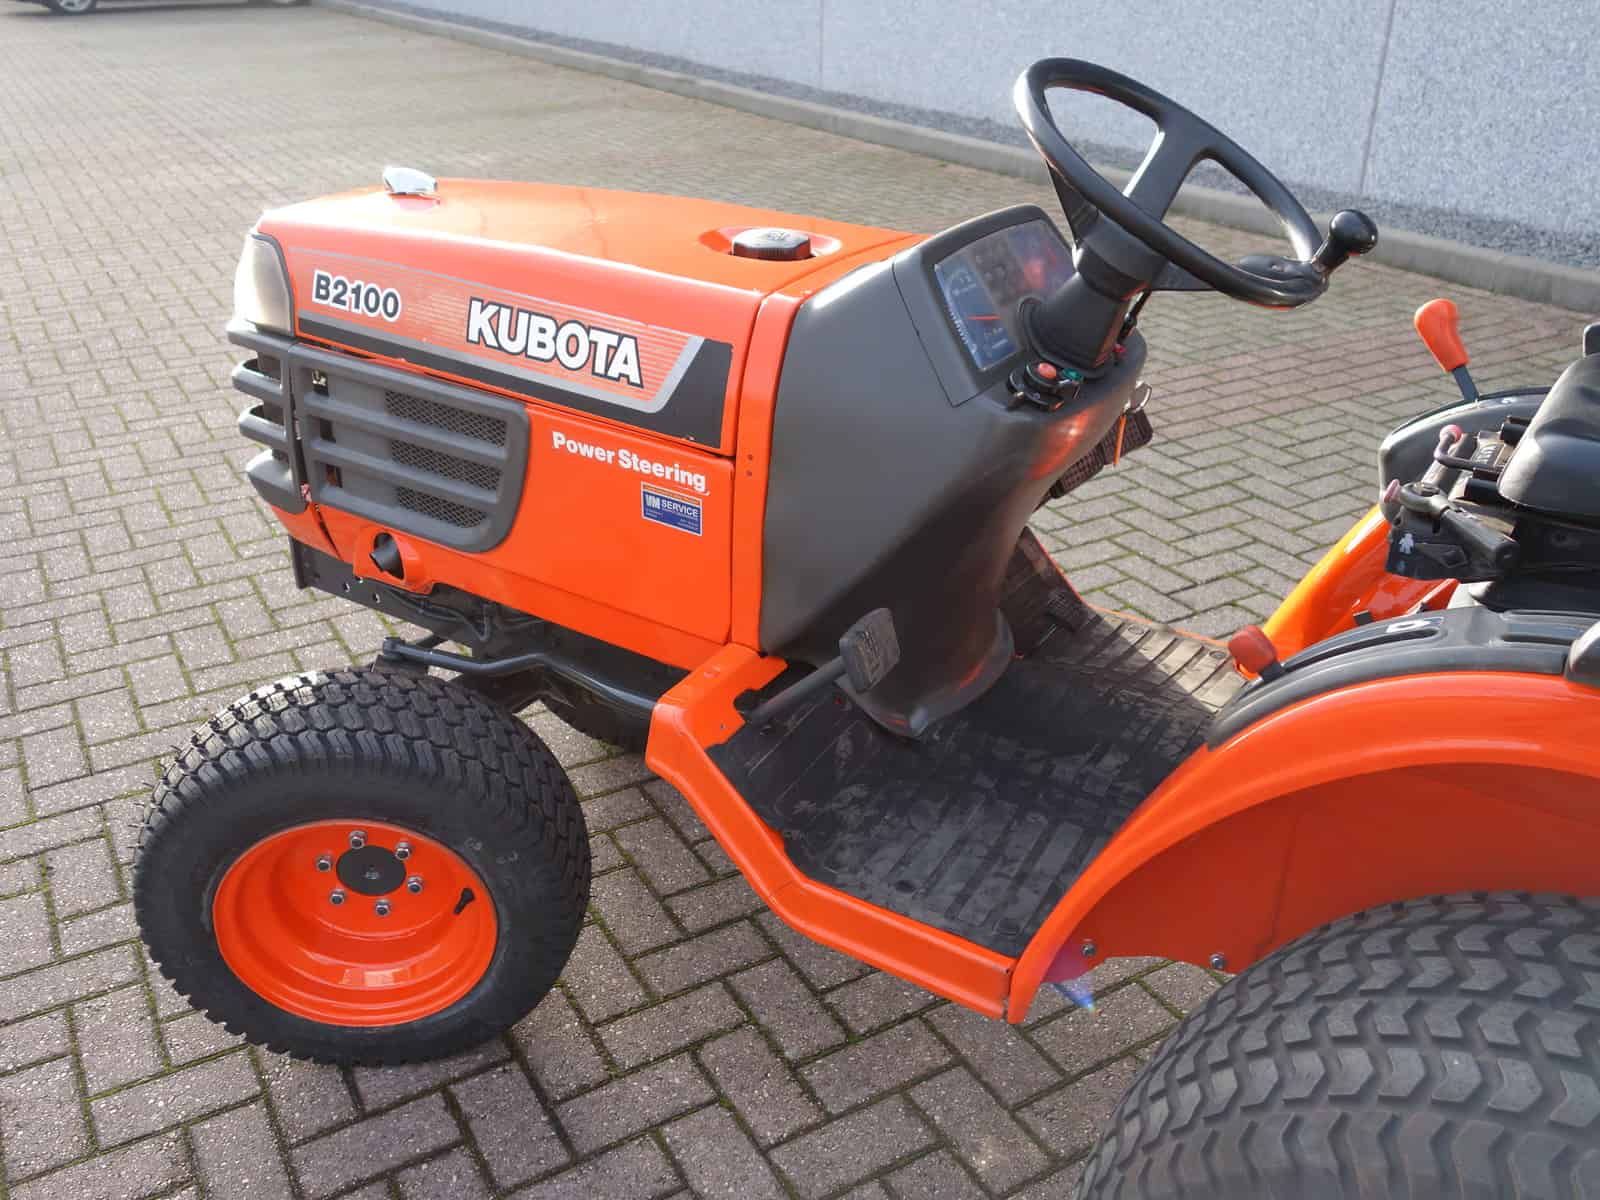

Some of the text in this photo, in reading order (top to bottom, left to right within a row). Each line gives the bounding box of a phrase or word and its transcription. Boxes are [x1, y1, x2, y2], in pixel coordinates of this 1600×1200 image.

[312, 270, 401, 321] B2100
[467, 296, 644, 389] KUBOTA
[552, 431, 705, 492] Power Steering
[661, 500, 699, 518] SERVICE
